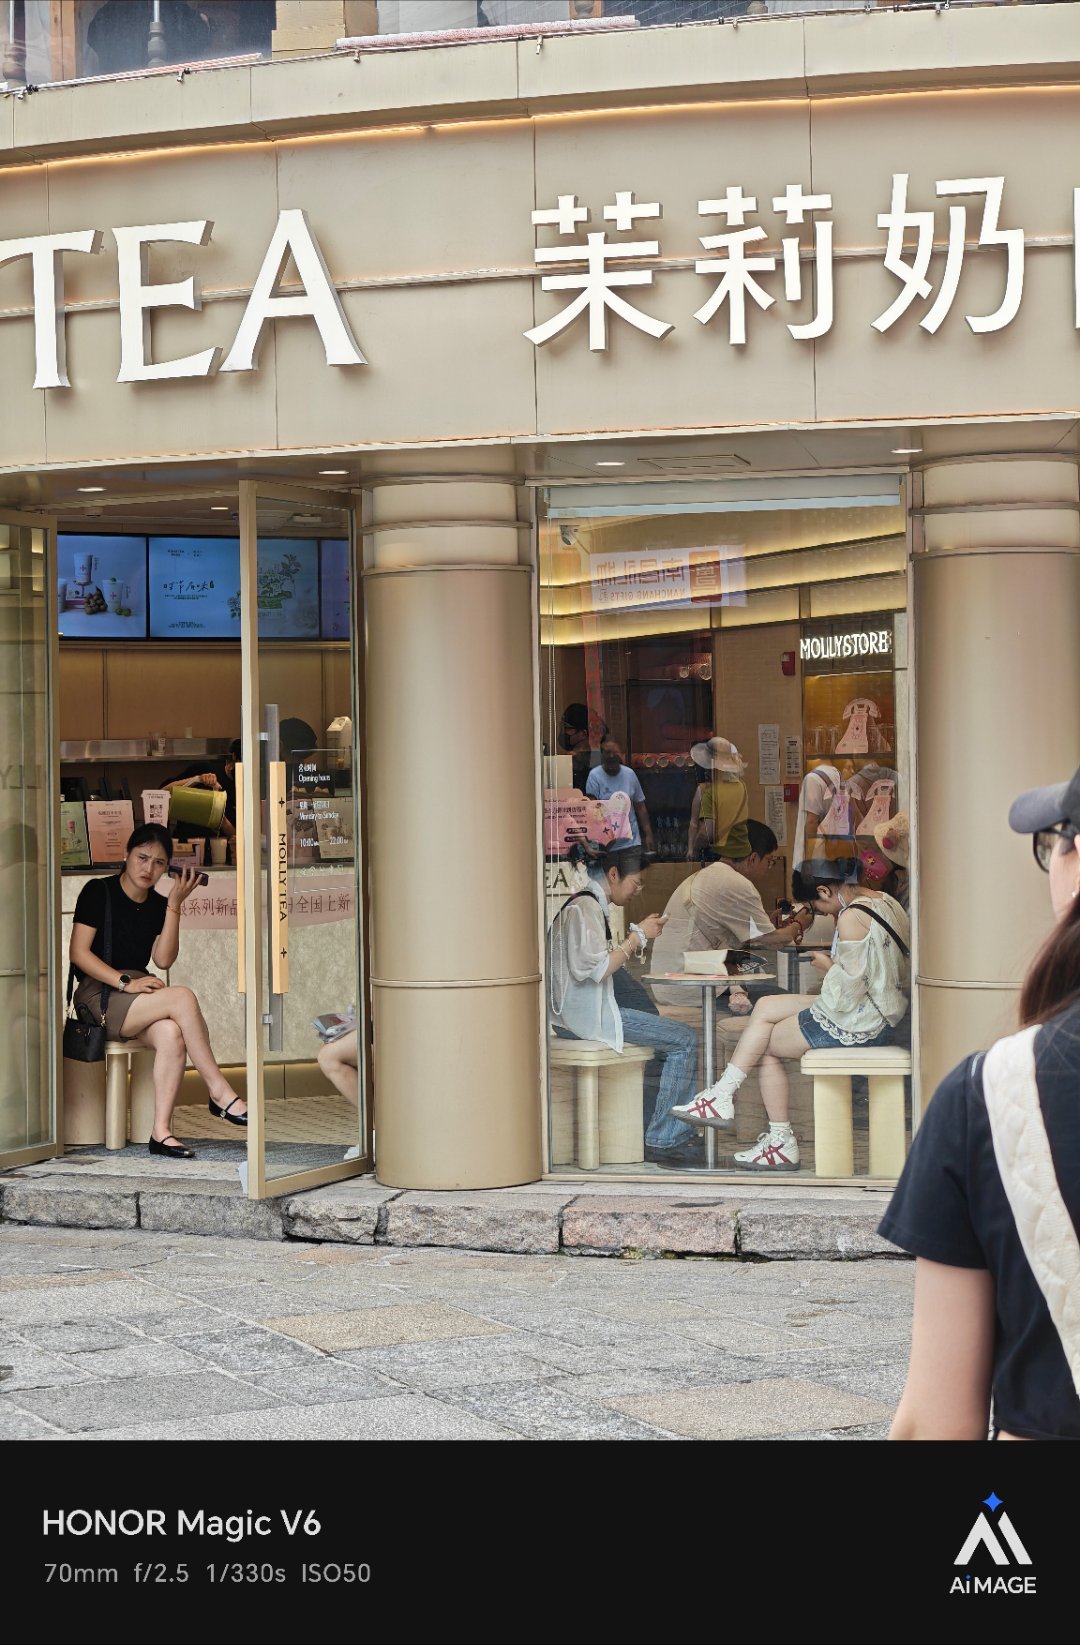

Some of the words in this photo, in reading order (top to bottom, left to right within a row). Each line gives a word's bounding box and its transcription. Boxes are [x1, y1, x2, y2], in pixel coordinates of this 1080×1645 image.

[522, 172, 1080, 353] 茉莉奶
[0, 208, 368, 390] TEA
[298, 774, 319, 784] Opening
[278, 833, 287, 887] MOLLY
[279, 891, 288, 922] TEA
